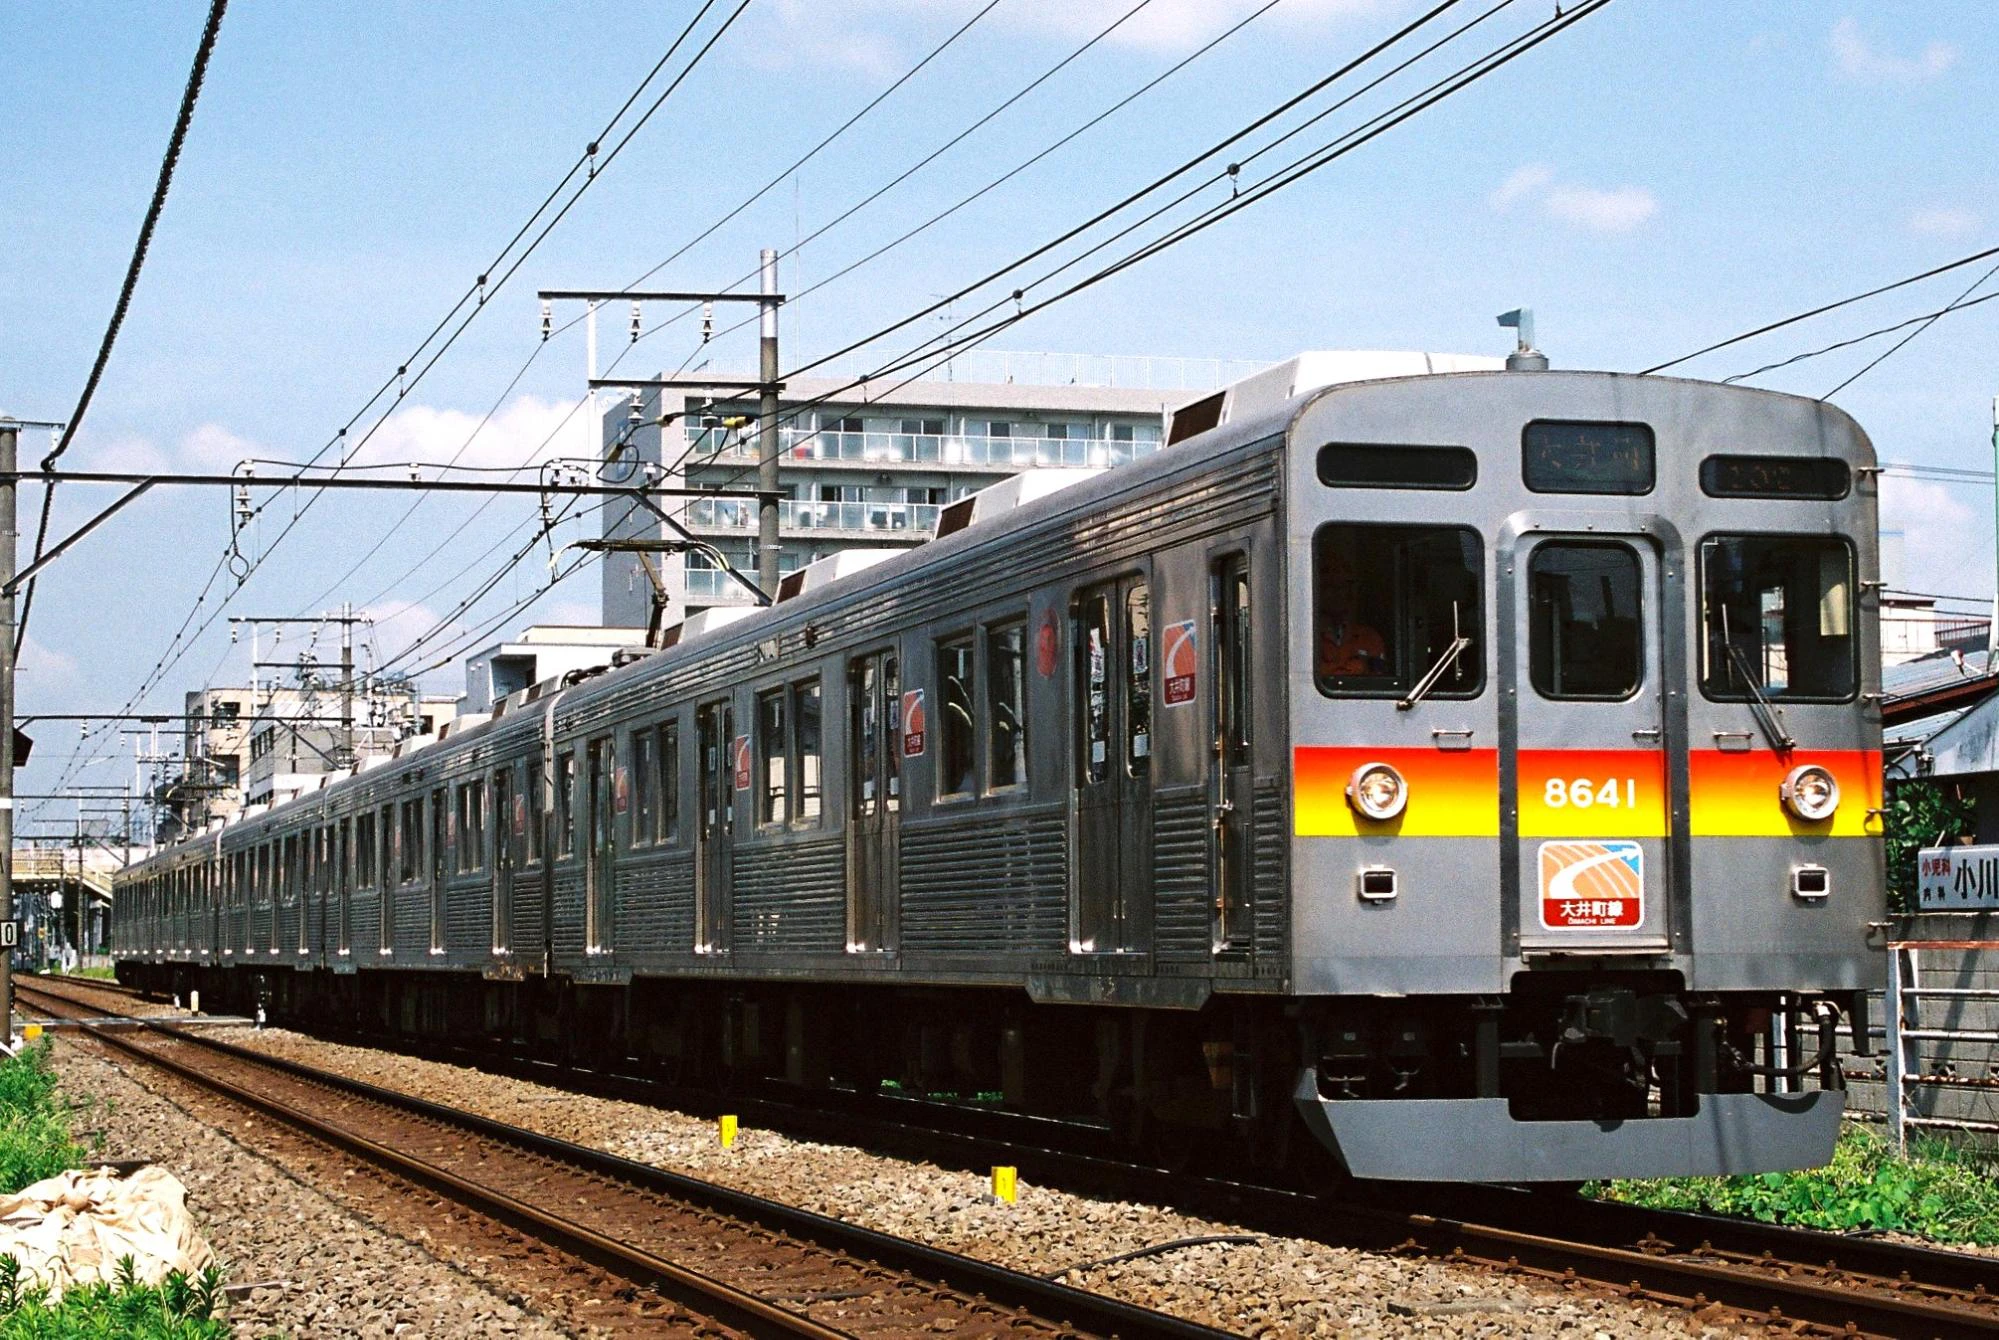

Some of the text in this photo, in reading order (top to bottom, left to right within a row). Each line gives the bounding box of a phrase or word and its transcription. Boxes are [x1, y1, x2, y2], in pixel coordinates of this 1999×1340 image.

[1544, 778, 1635, 808] 8641
[1923, 858, 1950, 876] 小児科
[1954, 858, 1998, 899] 小川
[1560, 901, 1624, 917] 大井町線
